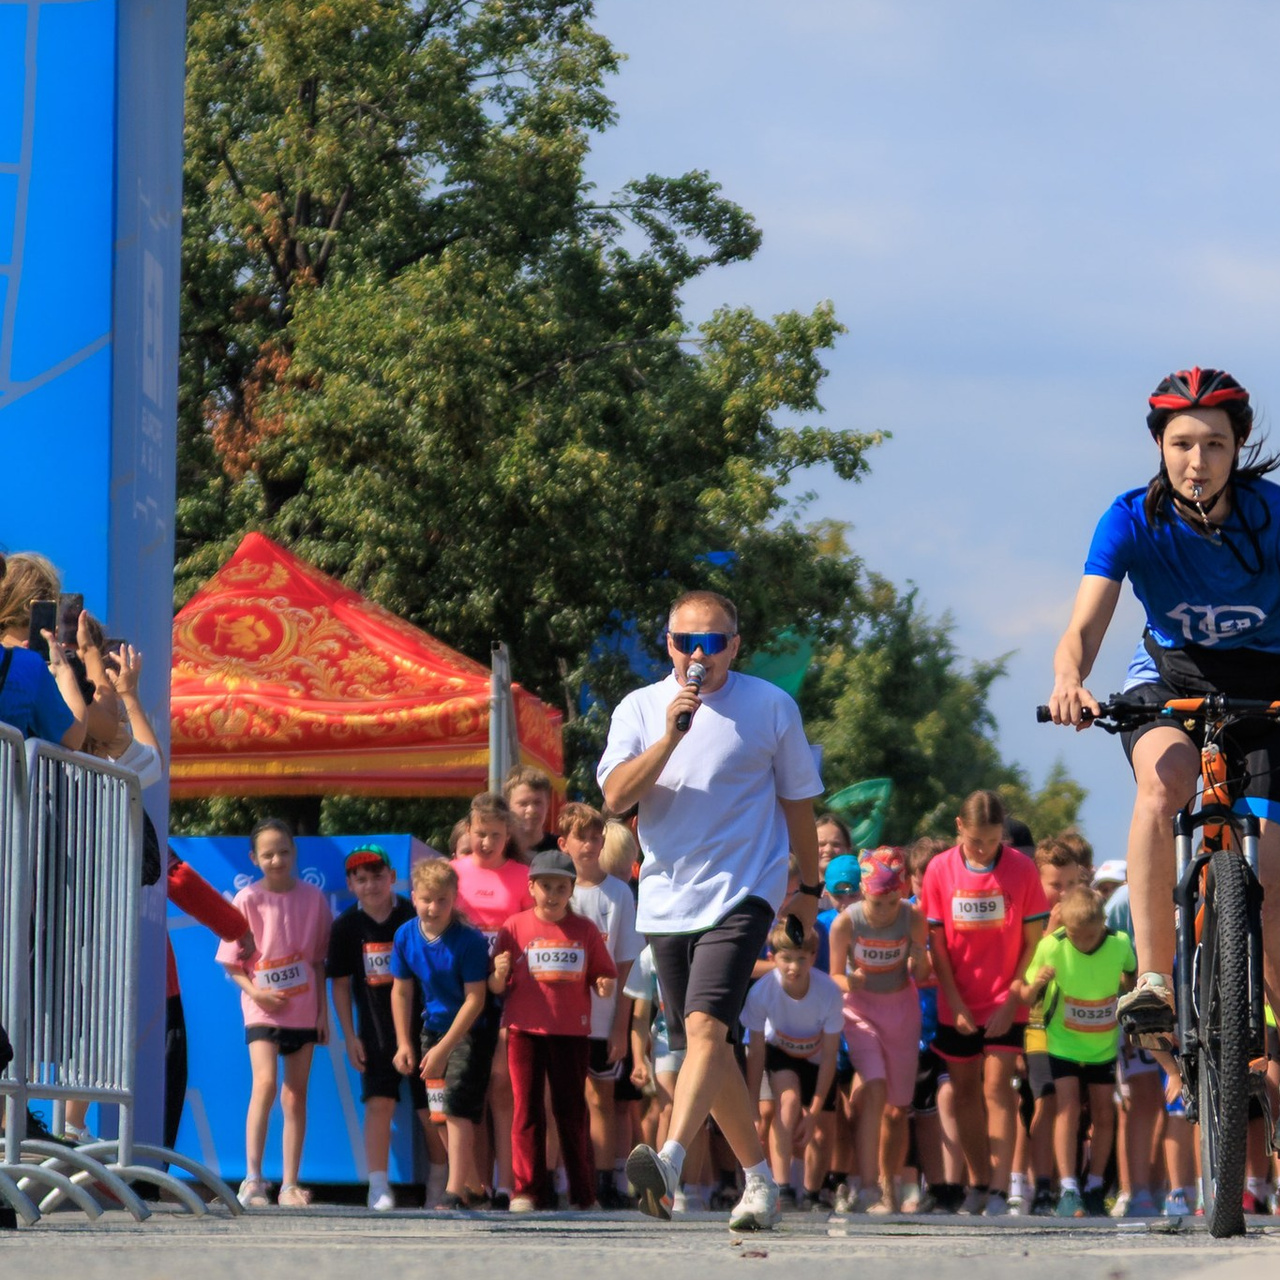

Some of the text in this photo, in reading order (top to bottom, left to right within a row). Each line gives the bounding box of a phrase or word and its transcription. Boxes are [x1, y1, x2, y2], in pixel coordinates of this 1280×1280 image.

[958, 901, 997, 913] 10159
[368, 955, 391, 968] 100
[535, 951, 578, 964] 10329
[264, 967, 300, 984] 10331
[1071, 1006, 1113, 1019] 10325
